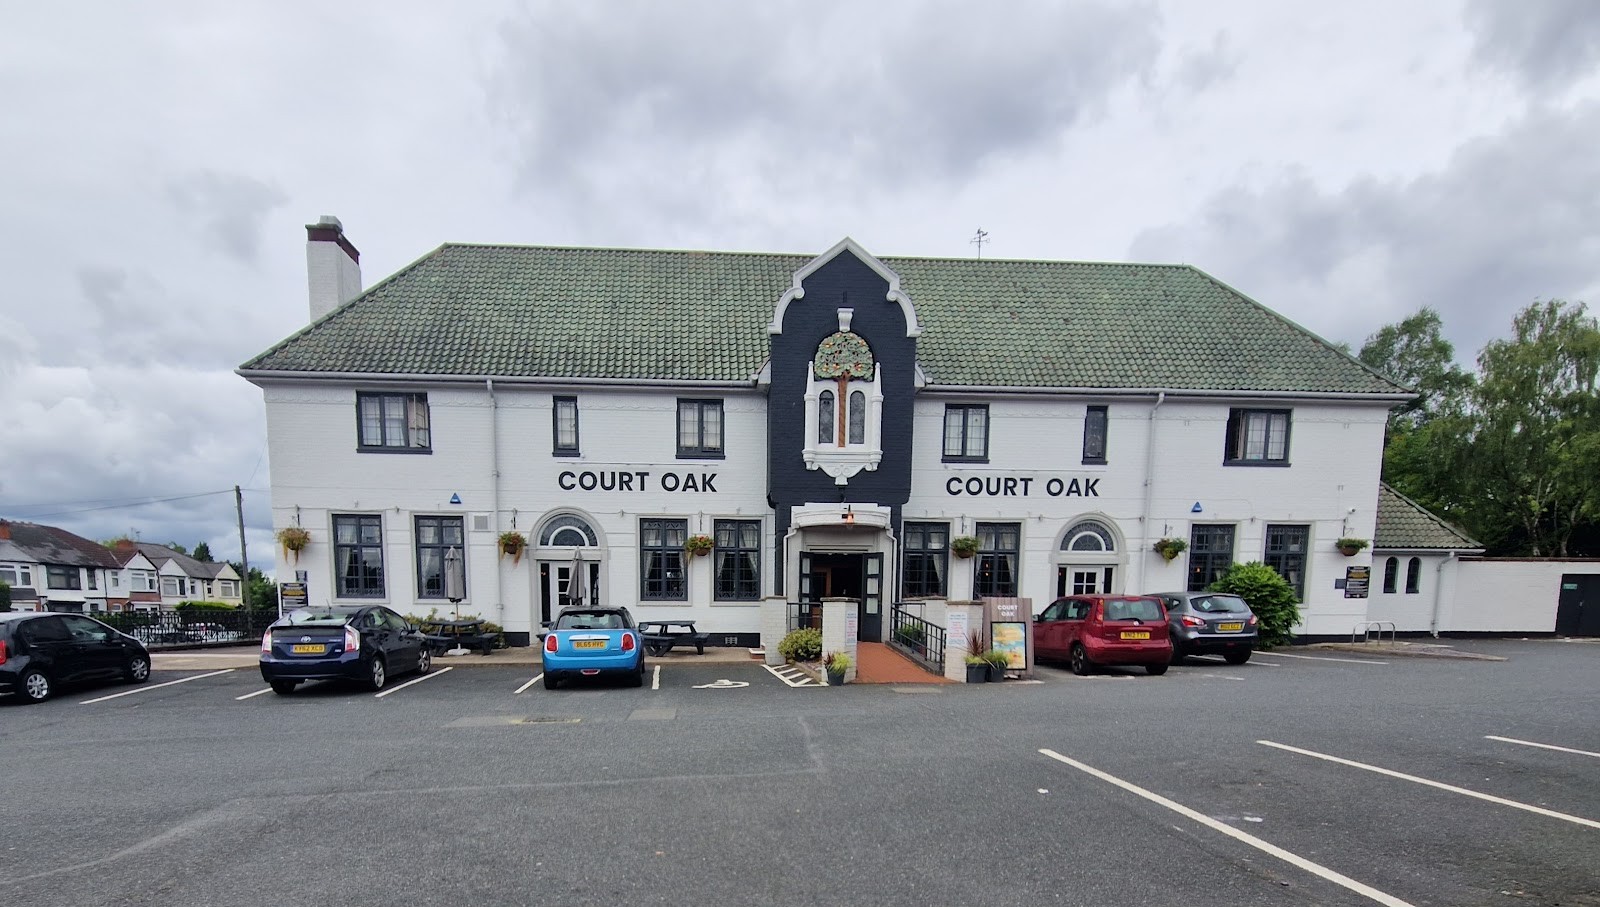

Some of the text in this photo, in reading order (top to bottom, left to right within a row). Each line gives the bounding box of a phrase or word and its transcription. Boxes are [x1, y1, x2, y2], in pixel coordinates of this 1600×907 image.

[558, 471, 718, 492] COURT OAK
[946, 477, 1100, 497] COURT OAK
